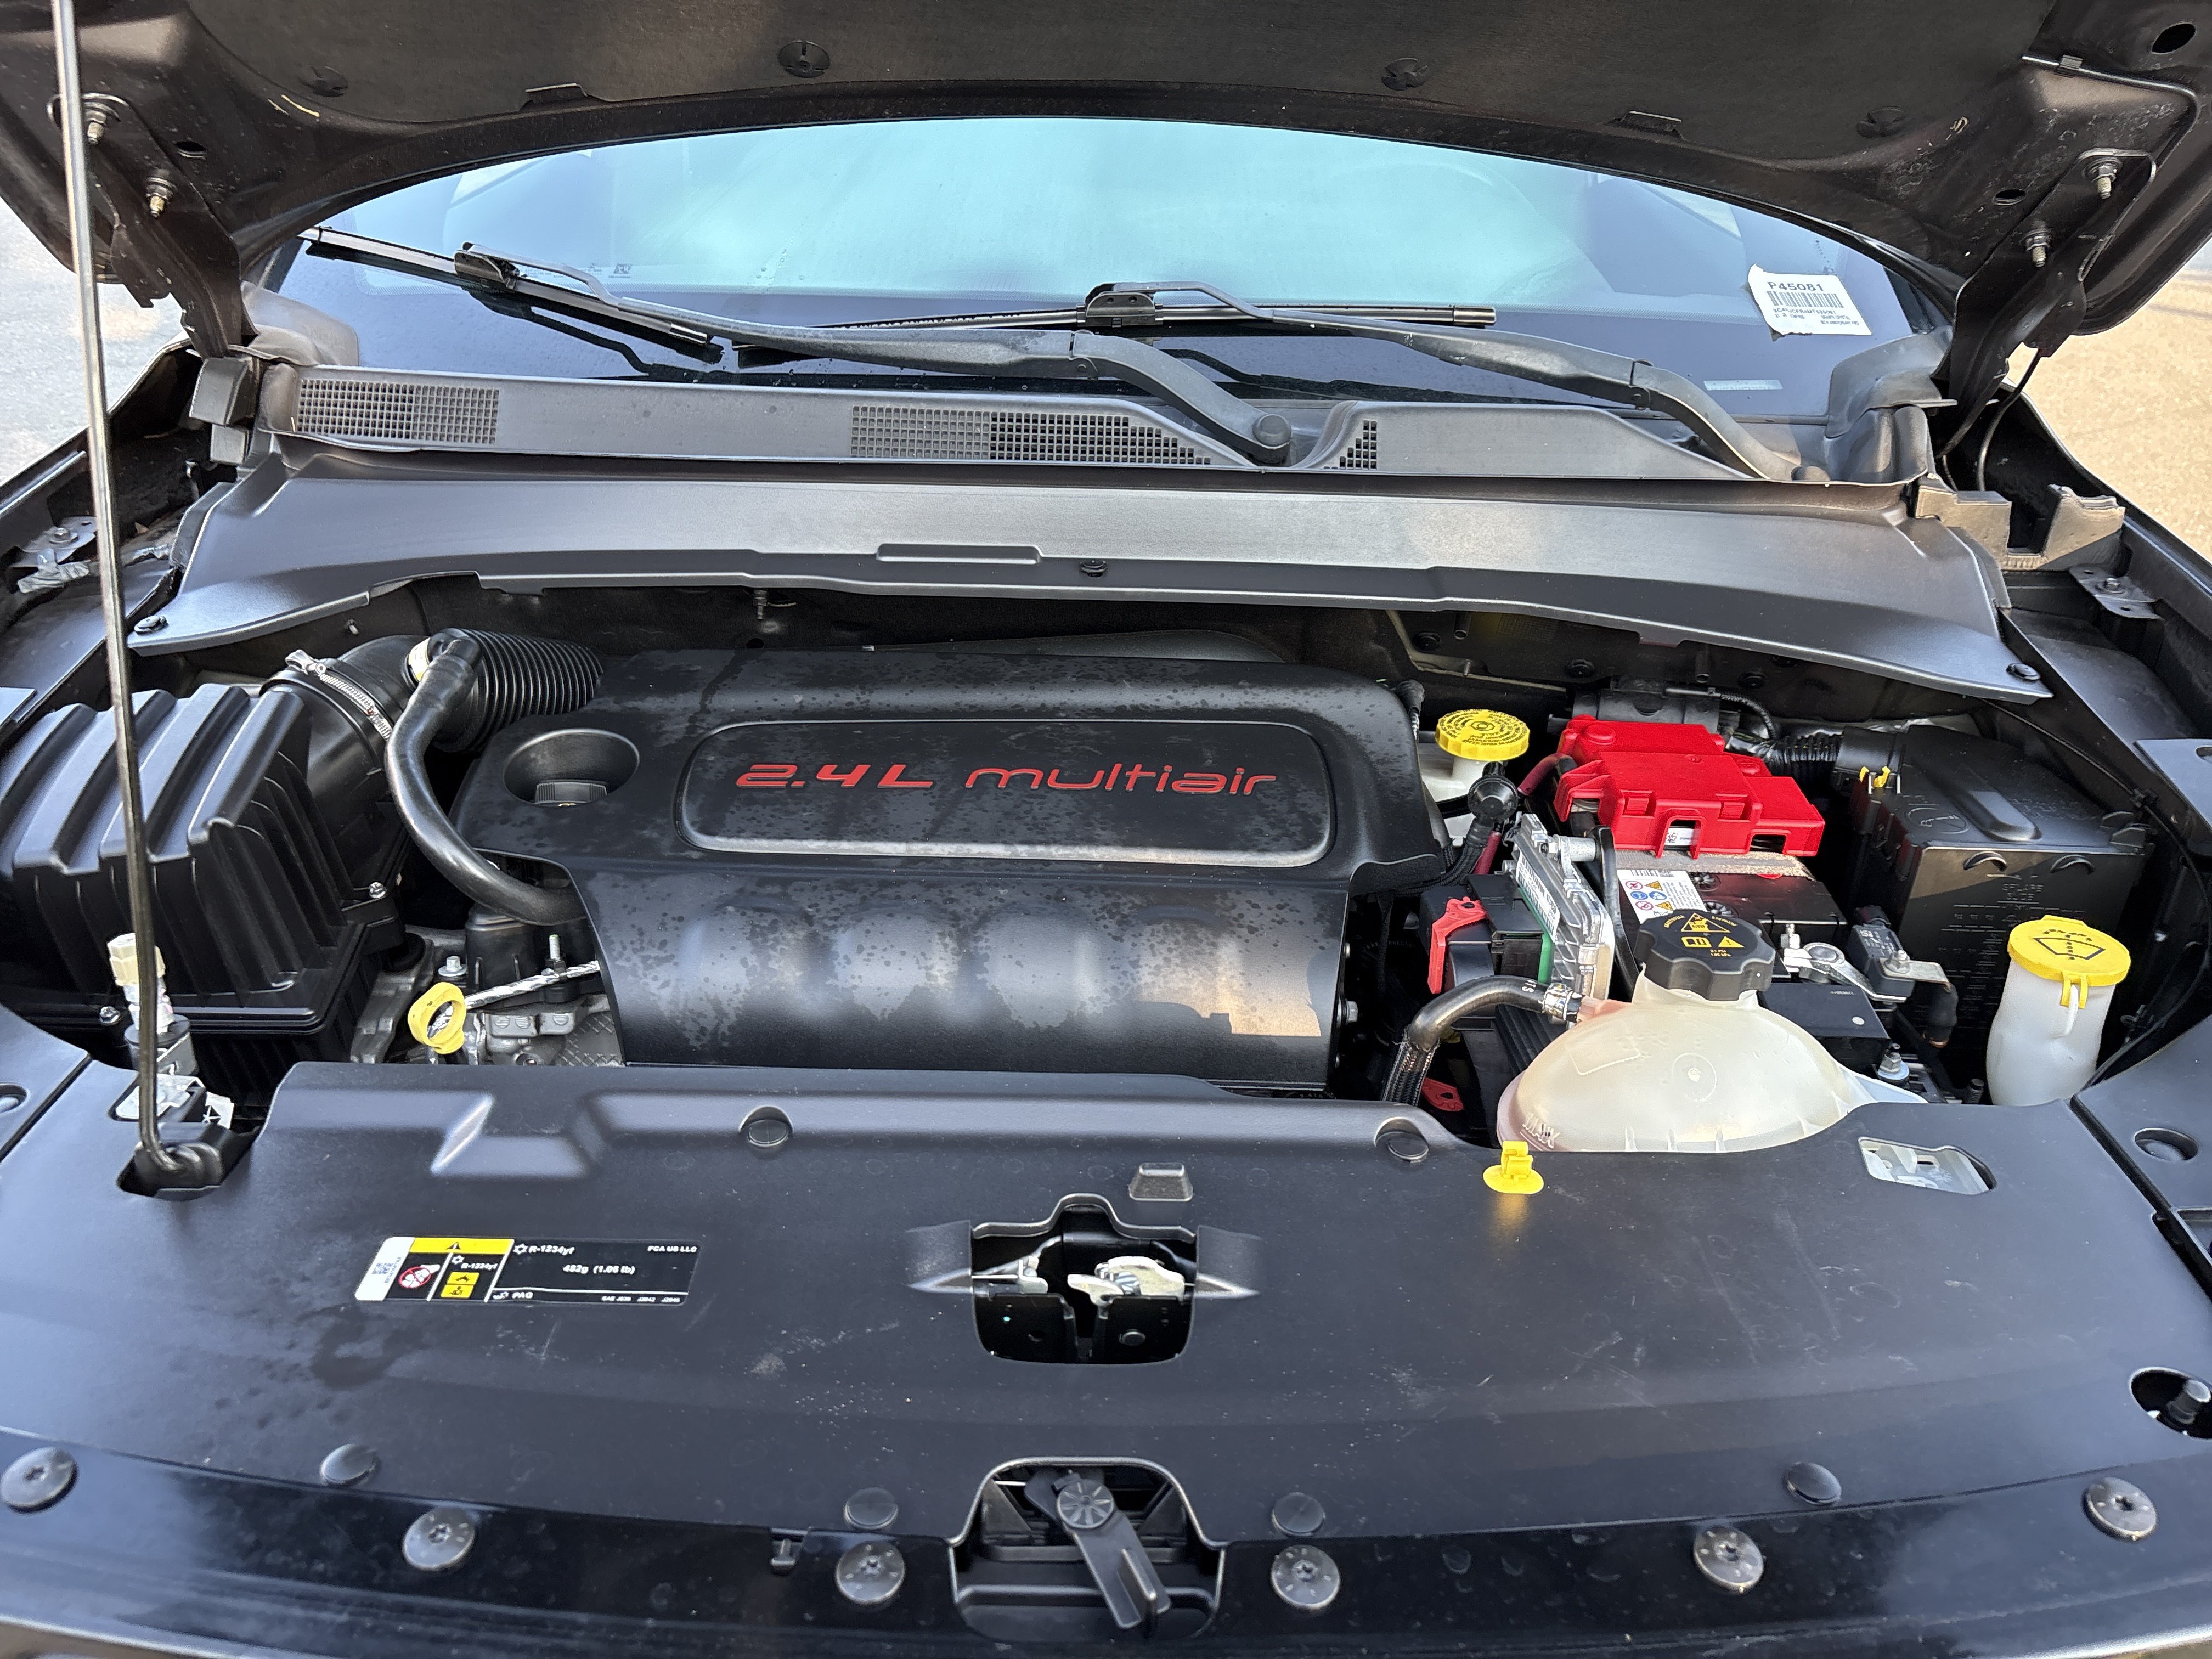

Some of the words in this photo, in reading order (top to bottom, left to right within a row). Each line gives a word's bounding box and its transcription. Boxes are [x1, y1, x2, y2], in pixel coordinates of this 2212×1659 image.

[1767, 281, 1824, 292] P45081
[965, 763, 1276, 793] multiair
[528, 1245, 575, 1256] R-1234yf
[511, 1291, 534, 1300] PAG
